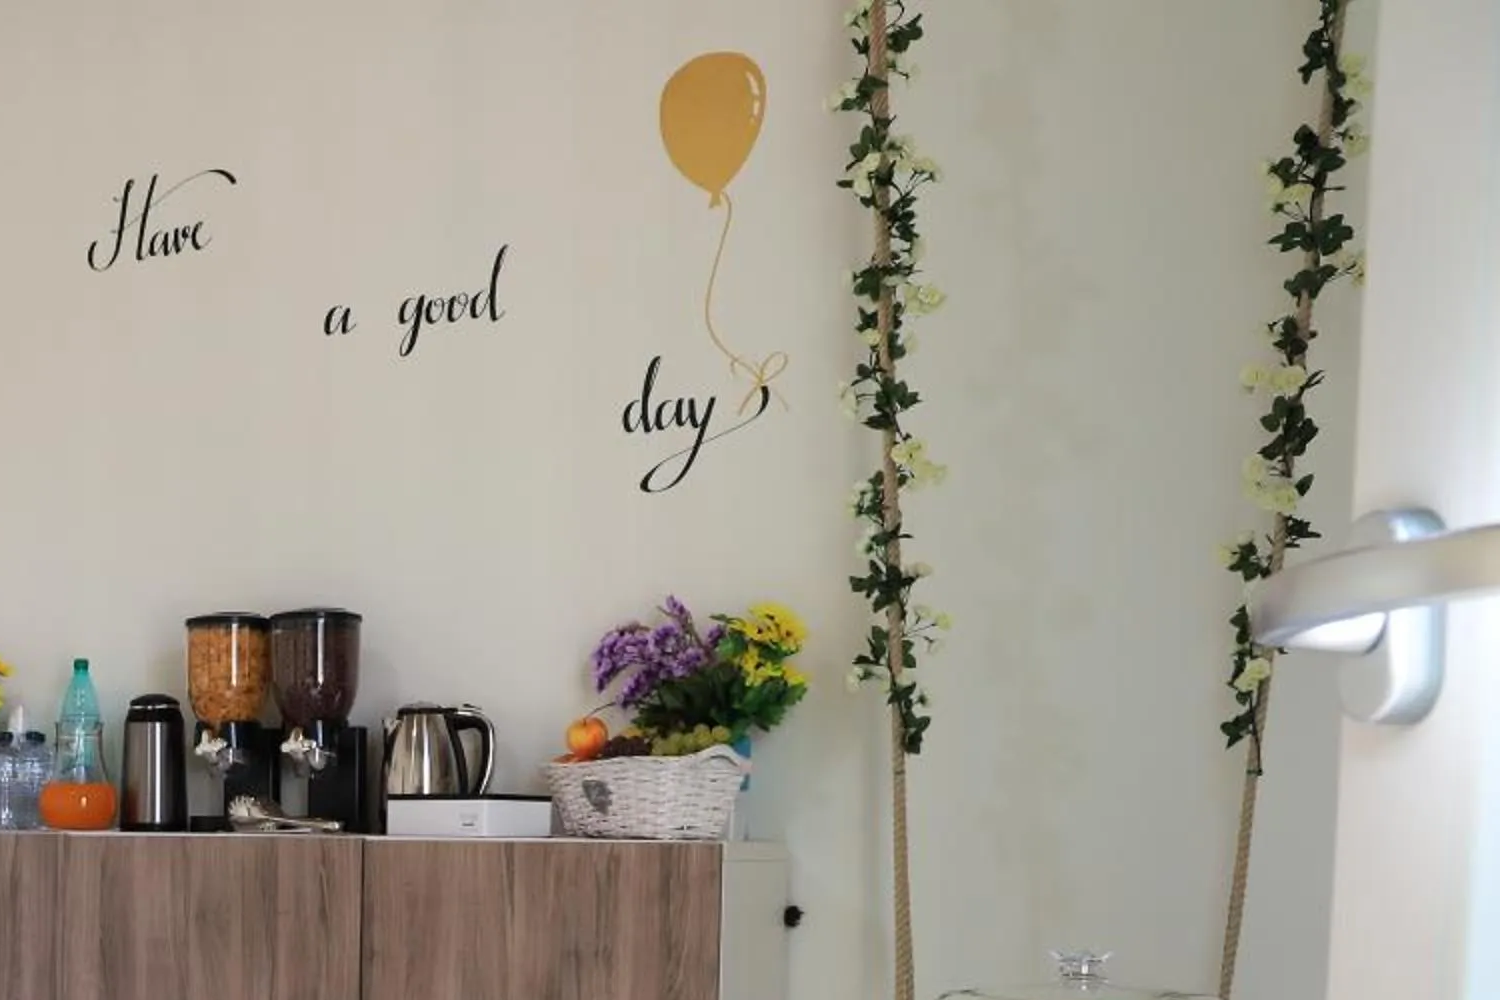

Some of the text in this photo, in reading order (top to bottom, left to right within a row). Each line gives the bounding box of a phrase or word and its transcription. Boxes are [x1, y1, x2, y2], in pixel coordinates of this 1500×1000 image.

[87, 169, 237, 272] Have
[323, 244, 508, 357] a good
[622, 355, 770, 493] day
